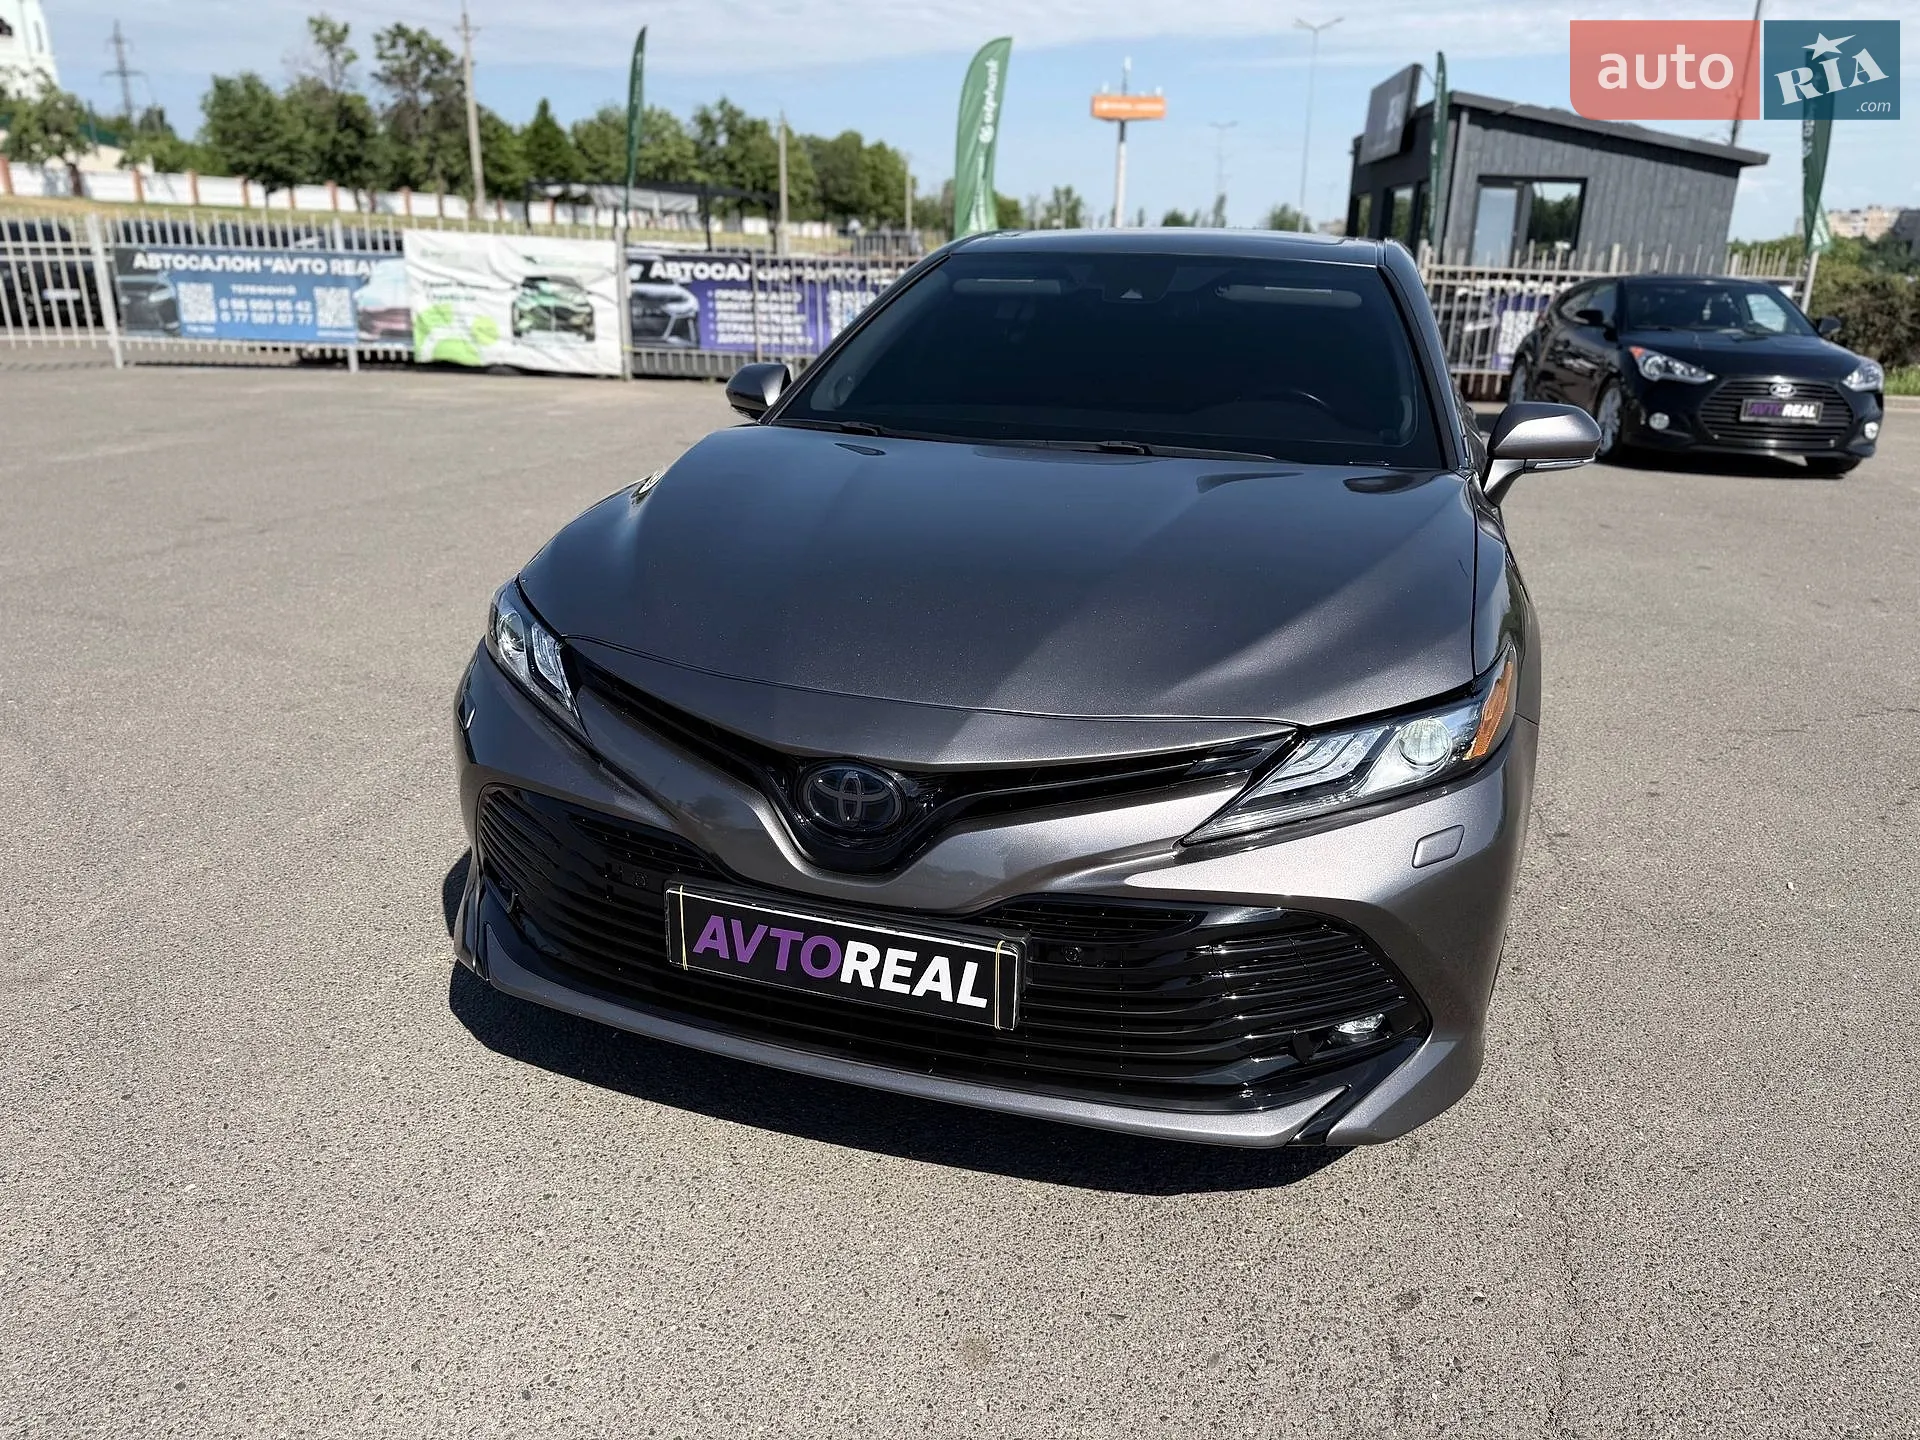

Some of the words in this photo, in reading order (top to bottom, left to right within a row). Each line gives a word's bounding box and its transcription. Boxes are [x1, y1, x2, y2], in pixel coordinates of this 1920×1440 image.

[133, 253, 261, 273] АВТОСАЛОН
[1749, 403, 1816, 418] AVTOREAL
[692, 915, 988, 1009] AVTOREAL
